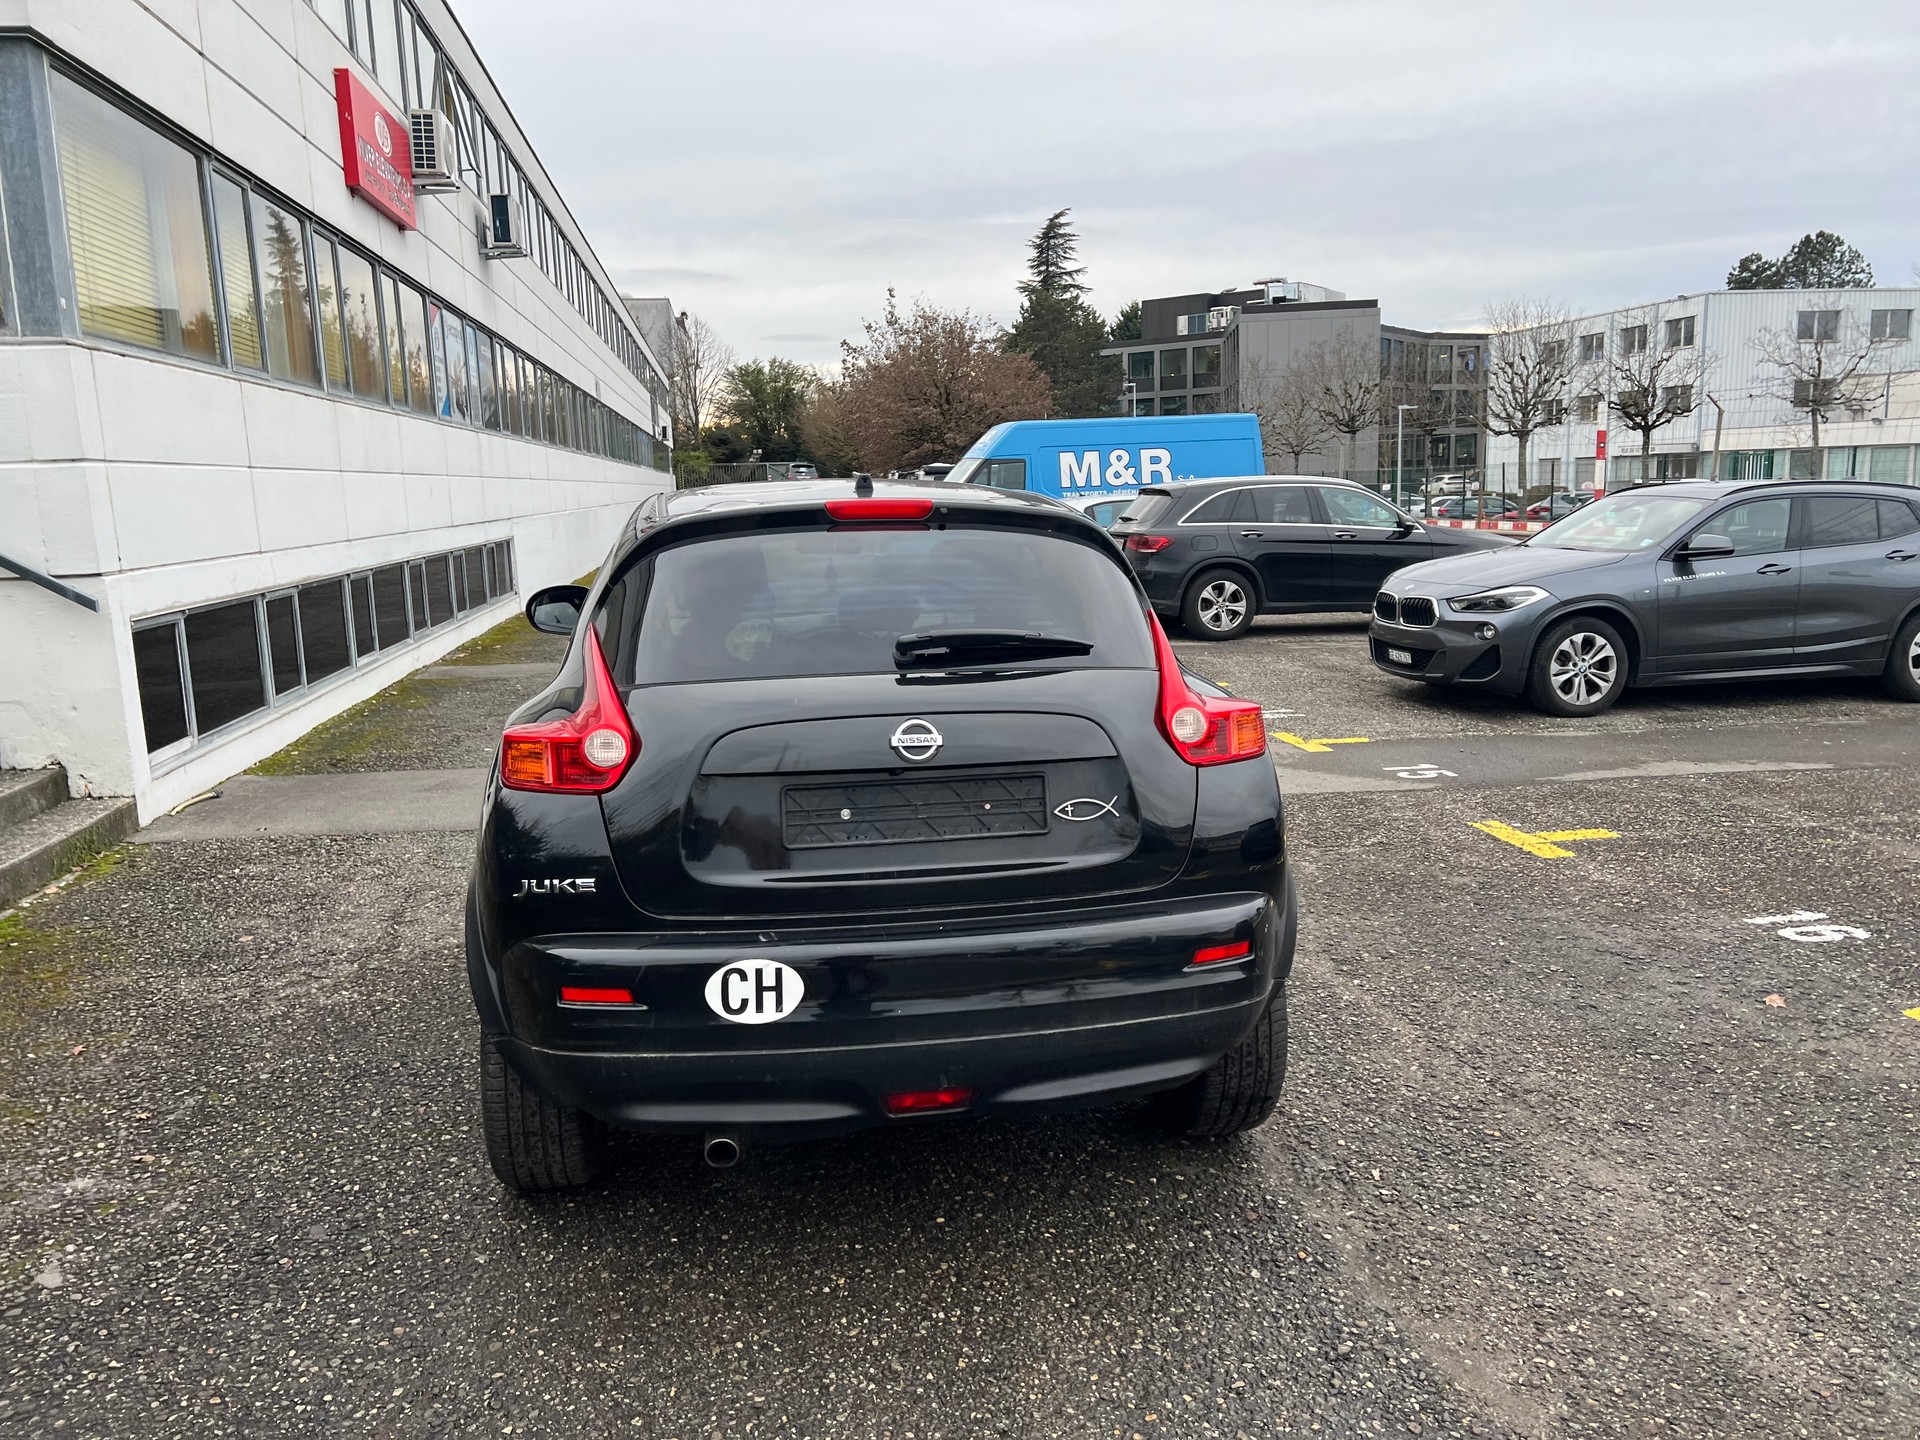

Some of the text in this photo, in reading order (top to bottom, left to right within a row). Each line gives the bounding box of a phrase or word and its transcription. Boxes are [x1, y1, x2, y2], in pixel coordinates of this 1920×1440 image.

[1058, 447, 1174, 488] M&R
[897, 736, 938, 744] NISSAN
[512, 877, 597, 898] JUKE
[720, 967, 784, 1016] CH
